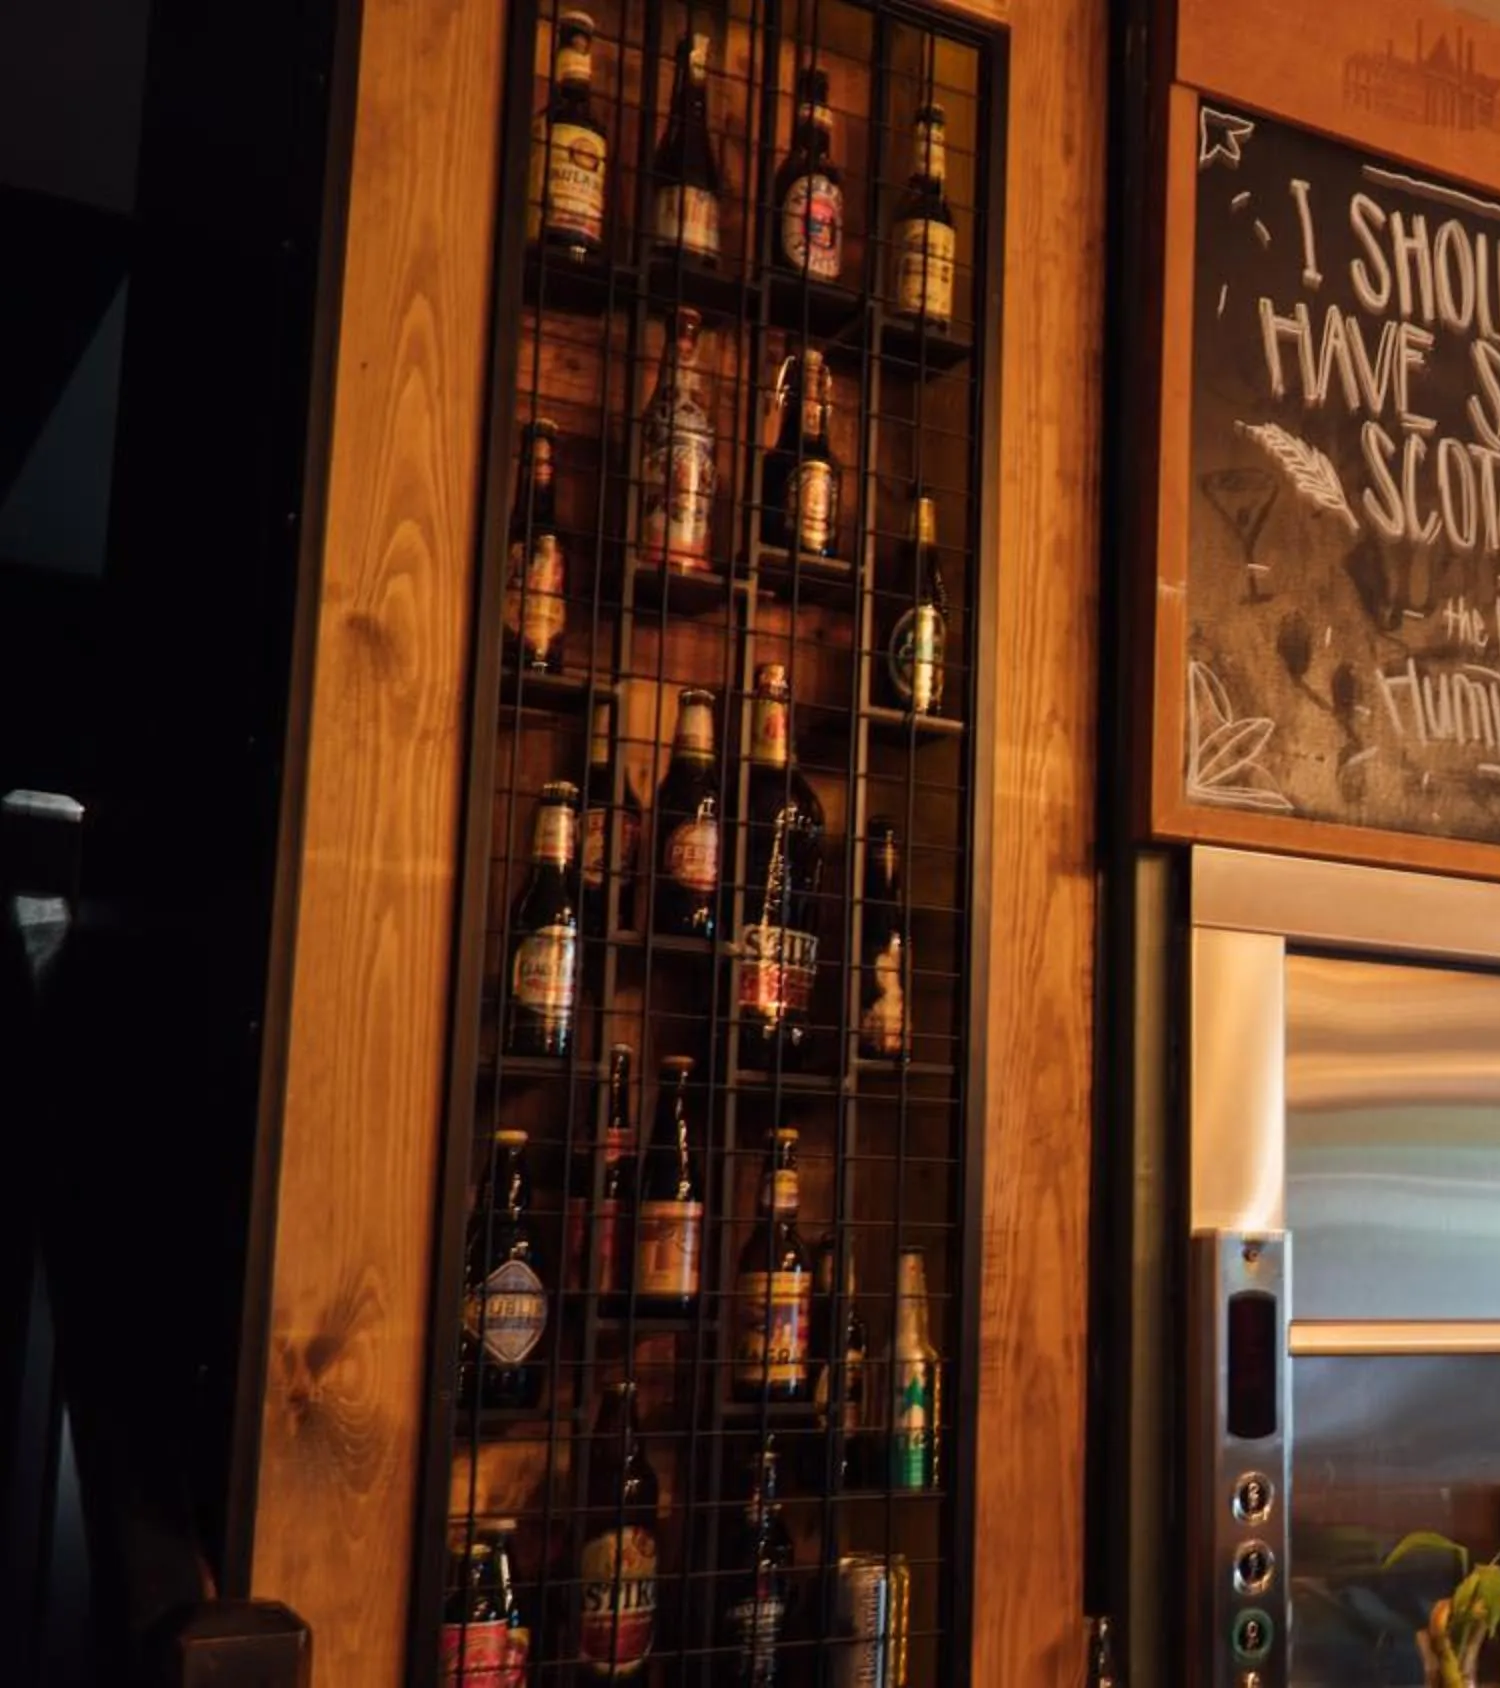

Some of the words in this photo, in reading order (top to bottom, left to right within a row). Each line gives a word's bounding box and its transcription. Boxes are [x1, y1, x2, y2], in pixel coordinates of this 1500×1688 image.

[1291, 178, 1323, 287] I
[1260, 297, 1436, 430] HAVE
[1444, 596, 1489, 648] the
